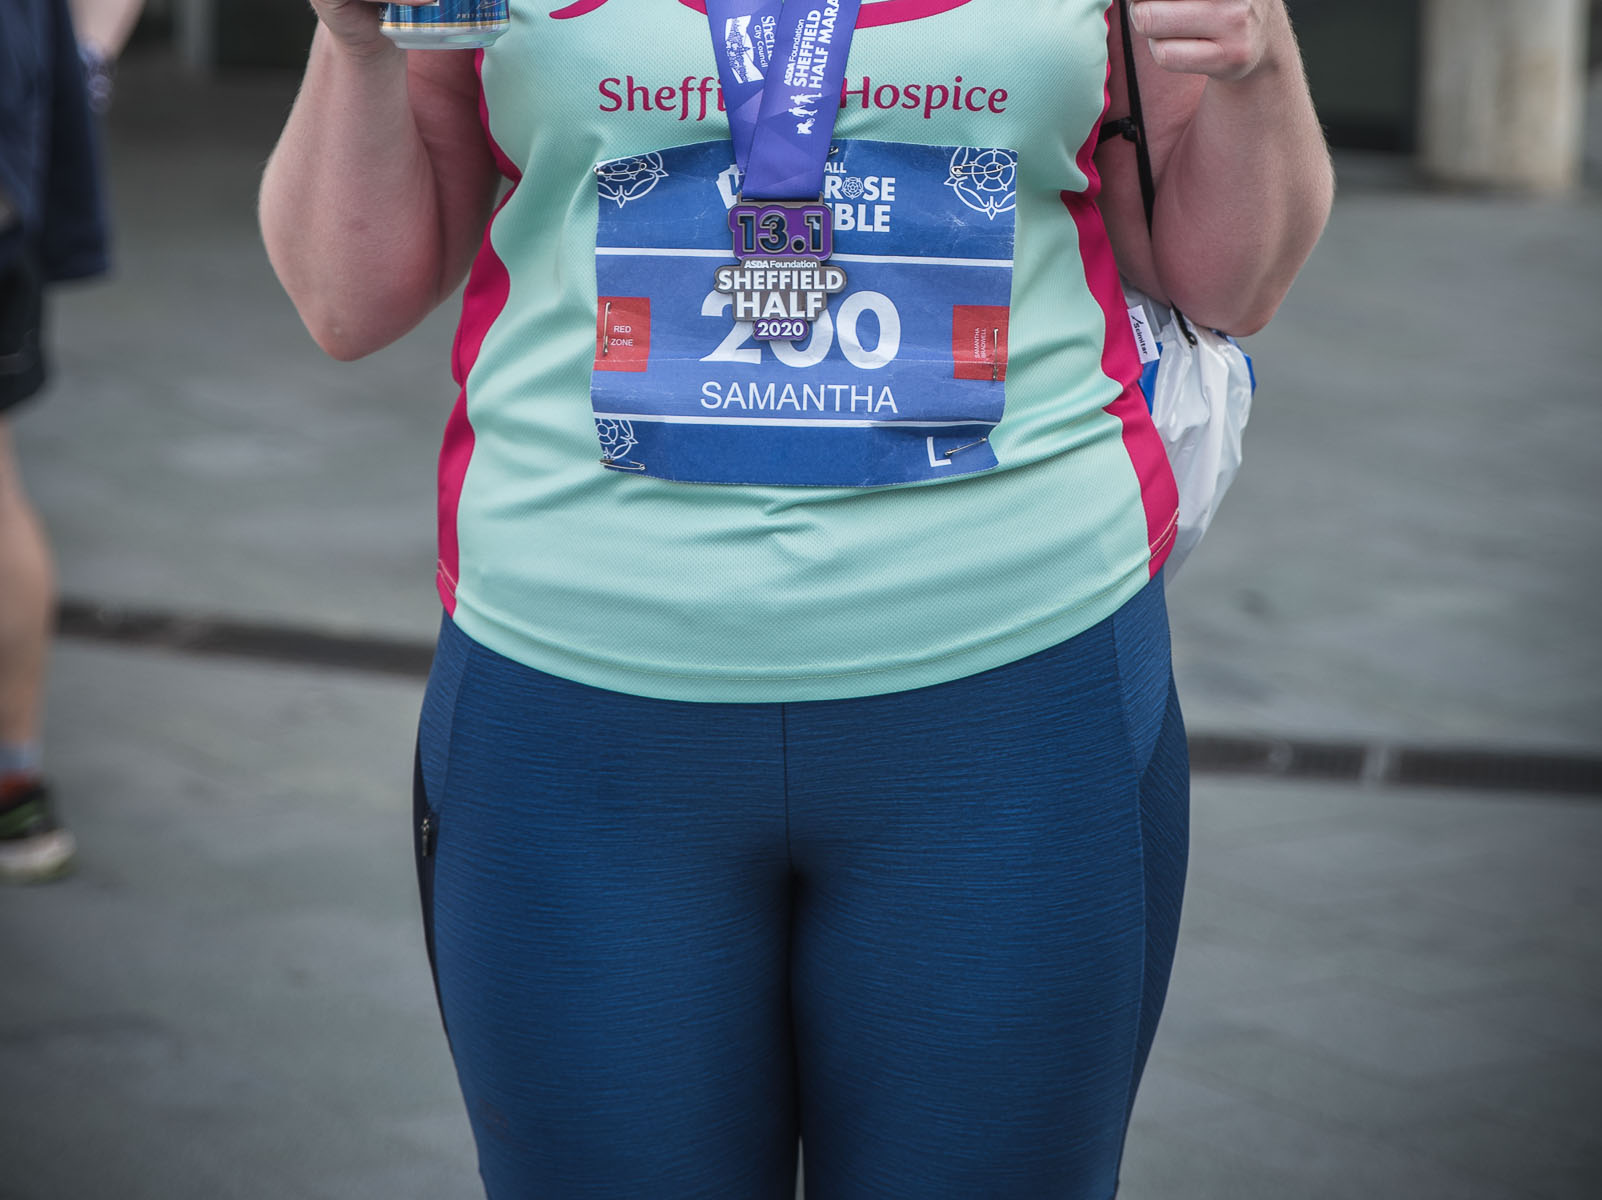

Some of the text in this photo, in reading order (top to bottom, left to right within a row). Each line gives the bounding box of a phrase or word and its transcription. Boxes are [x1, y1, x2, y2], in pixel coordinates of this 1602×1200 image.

[754, 25, 769, 68] City Council
[784, 19, 804, 86] ASDA Foundation
[793, 9, 821, 87] SHEFFIELD
[808, 50, 829, 89] HALF
[598, 75, 1009, 121] Sheffi Hospice
[738, 212, 824, 253] 13.1
[717, 270, 843, 290] SHEFFIELD
[743, 260, 817, 269] ASDA Foundation
[736, 291, 823, 318] HALF
[610, 337, 634, 347] ZONE
[613, 324, 632, 334] RED
[757, 321, 805, 337] 2020
[1133, 323, 1148, 355] Scimitar
[700, 381, 899, 414] SAMANTHA
